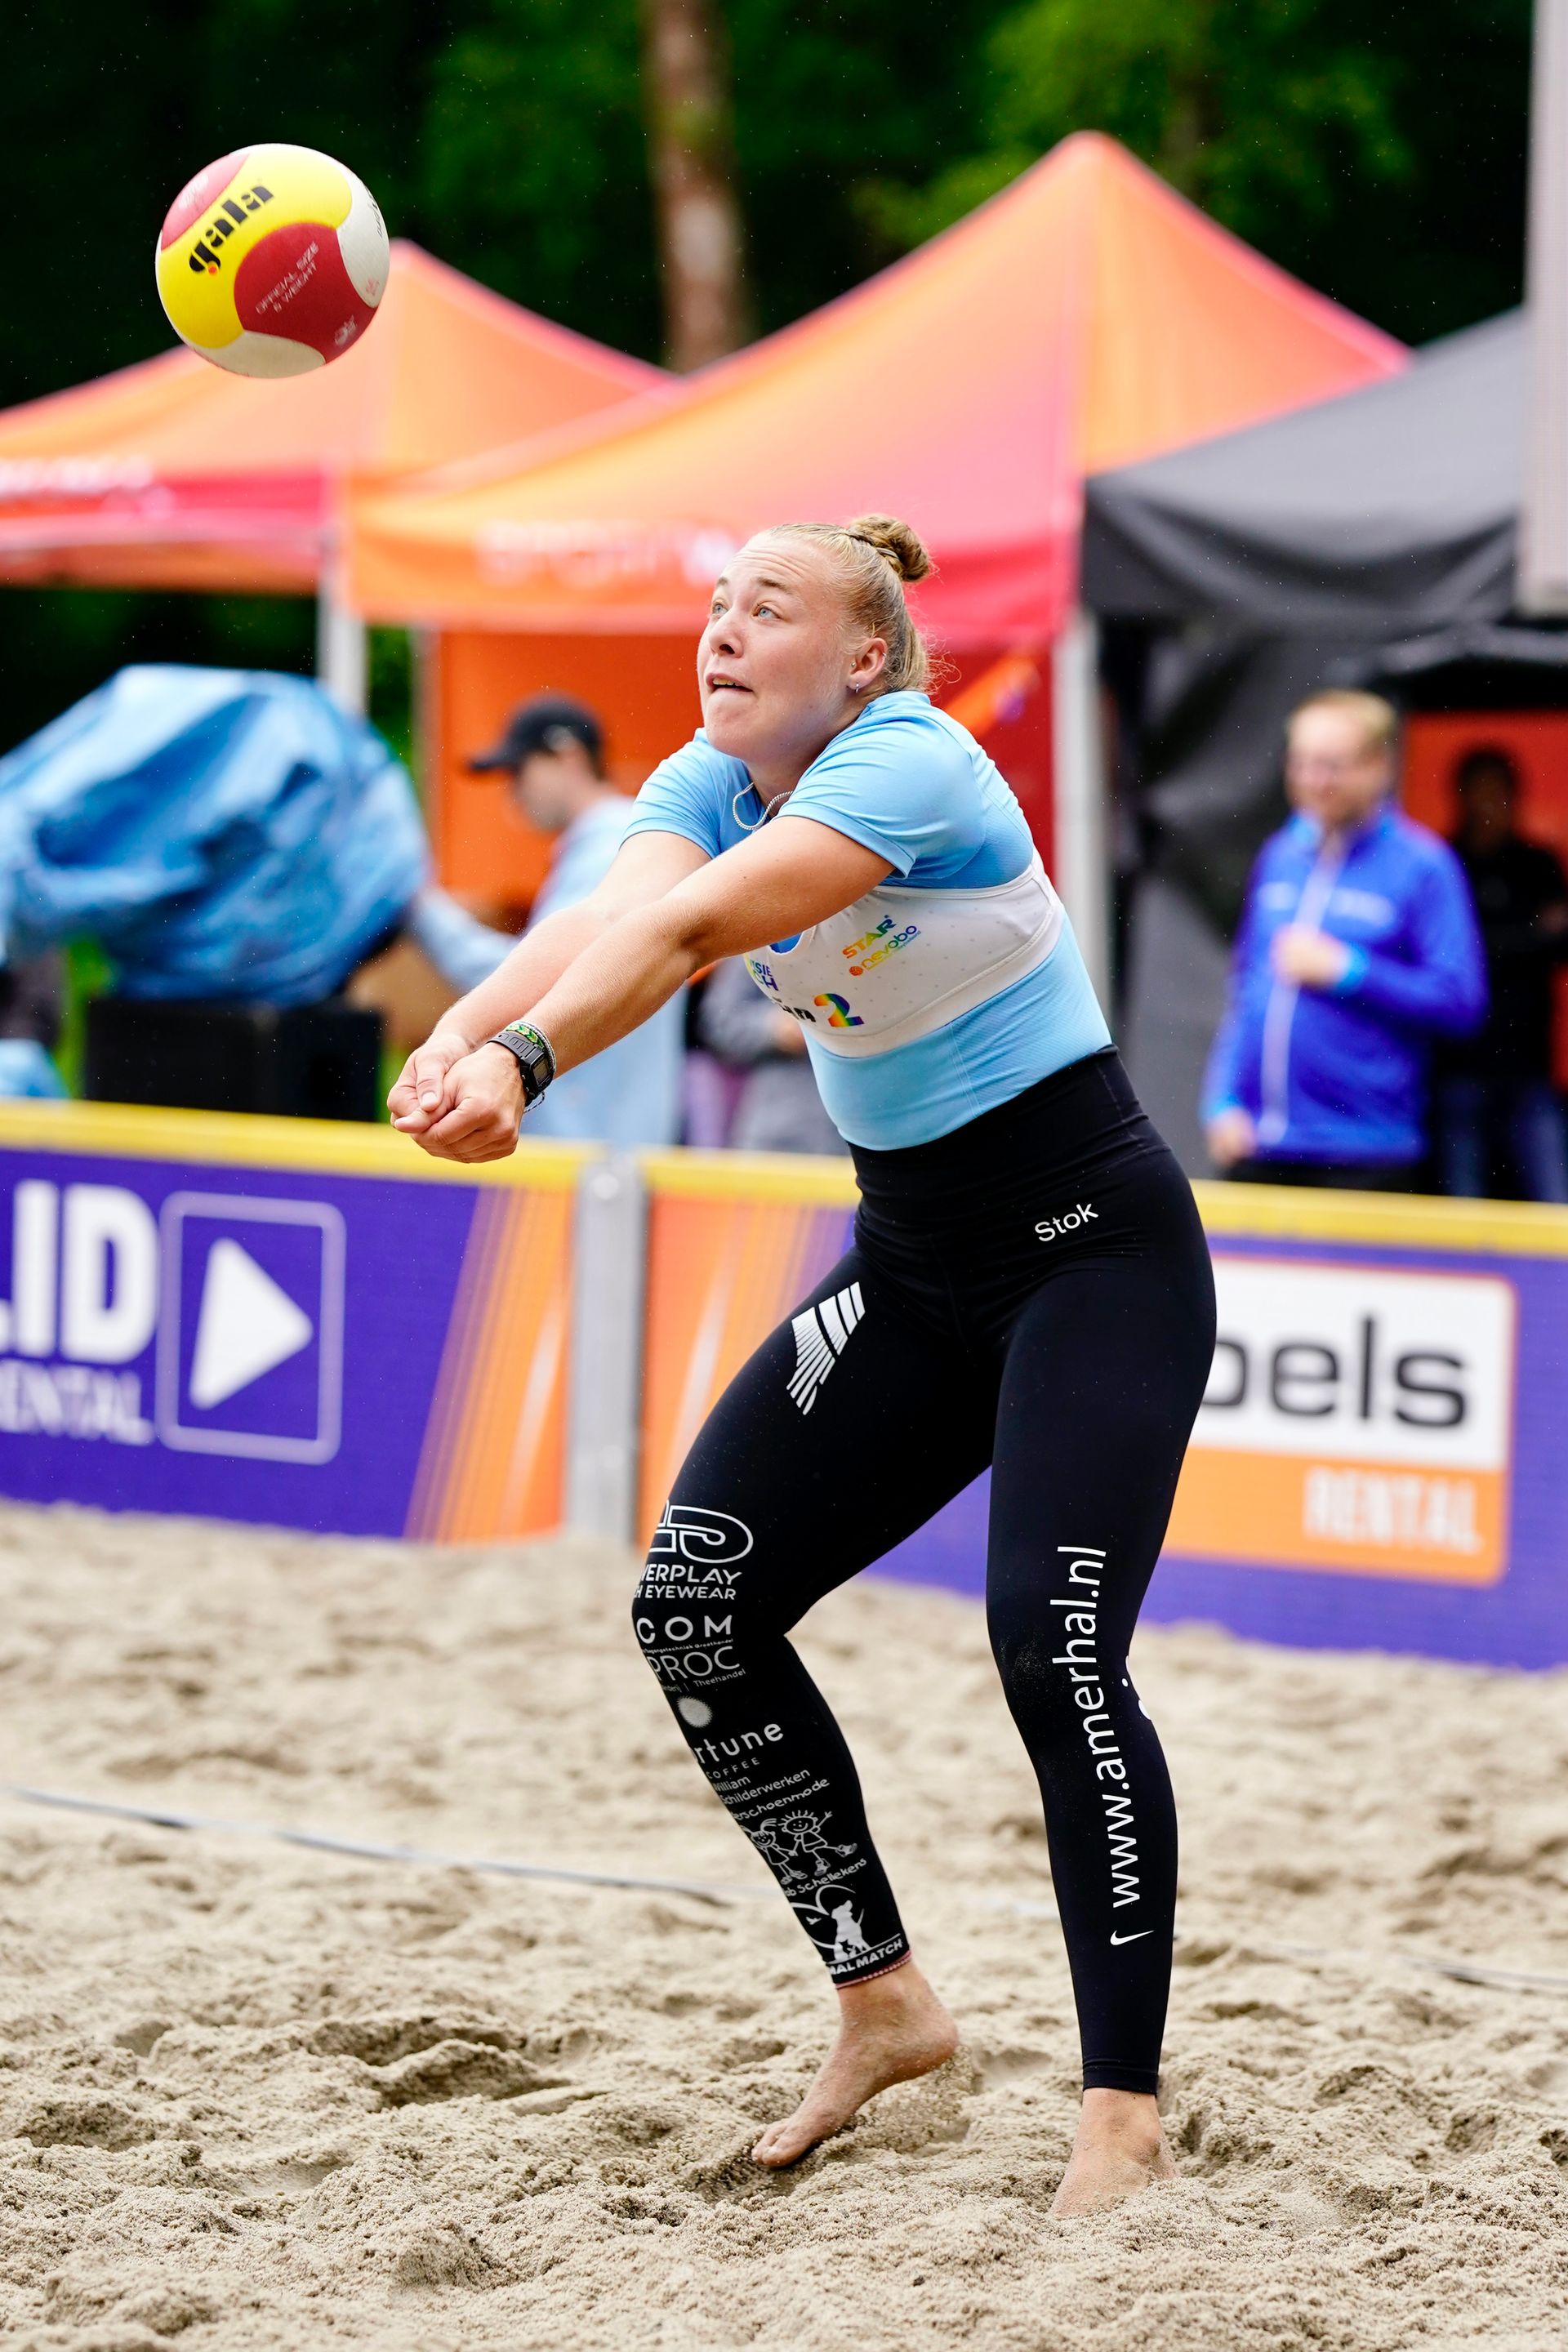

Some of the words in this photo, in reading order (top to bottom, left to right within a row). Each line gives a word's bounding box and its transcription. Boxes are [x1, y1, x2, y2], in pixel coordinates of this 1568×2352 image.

[189, 185, 274, 273] gala
[296, 240, 319, 272] SIZE
[842, 918, 897, 959] STAR
[862, 925, 917, 971] nevobo
[813, 993, 864, 1027] 2
[1034, 1203, 1099, 1242] Stok
[1305, 1466, 1485, 1555] RENTAL
[645, 1584, 737, 1601] EYEWEAR
[693, 1668, 746, 1688] Theehandel
[1049, 1545, 1141, 1909] www.amerhal.nl
[797, 1858, 867, 1894] Schellekens
[857, 1938, 903, 1969] MATCH
